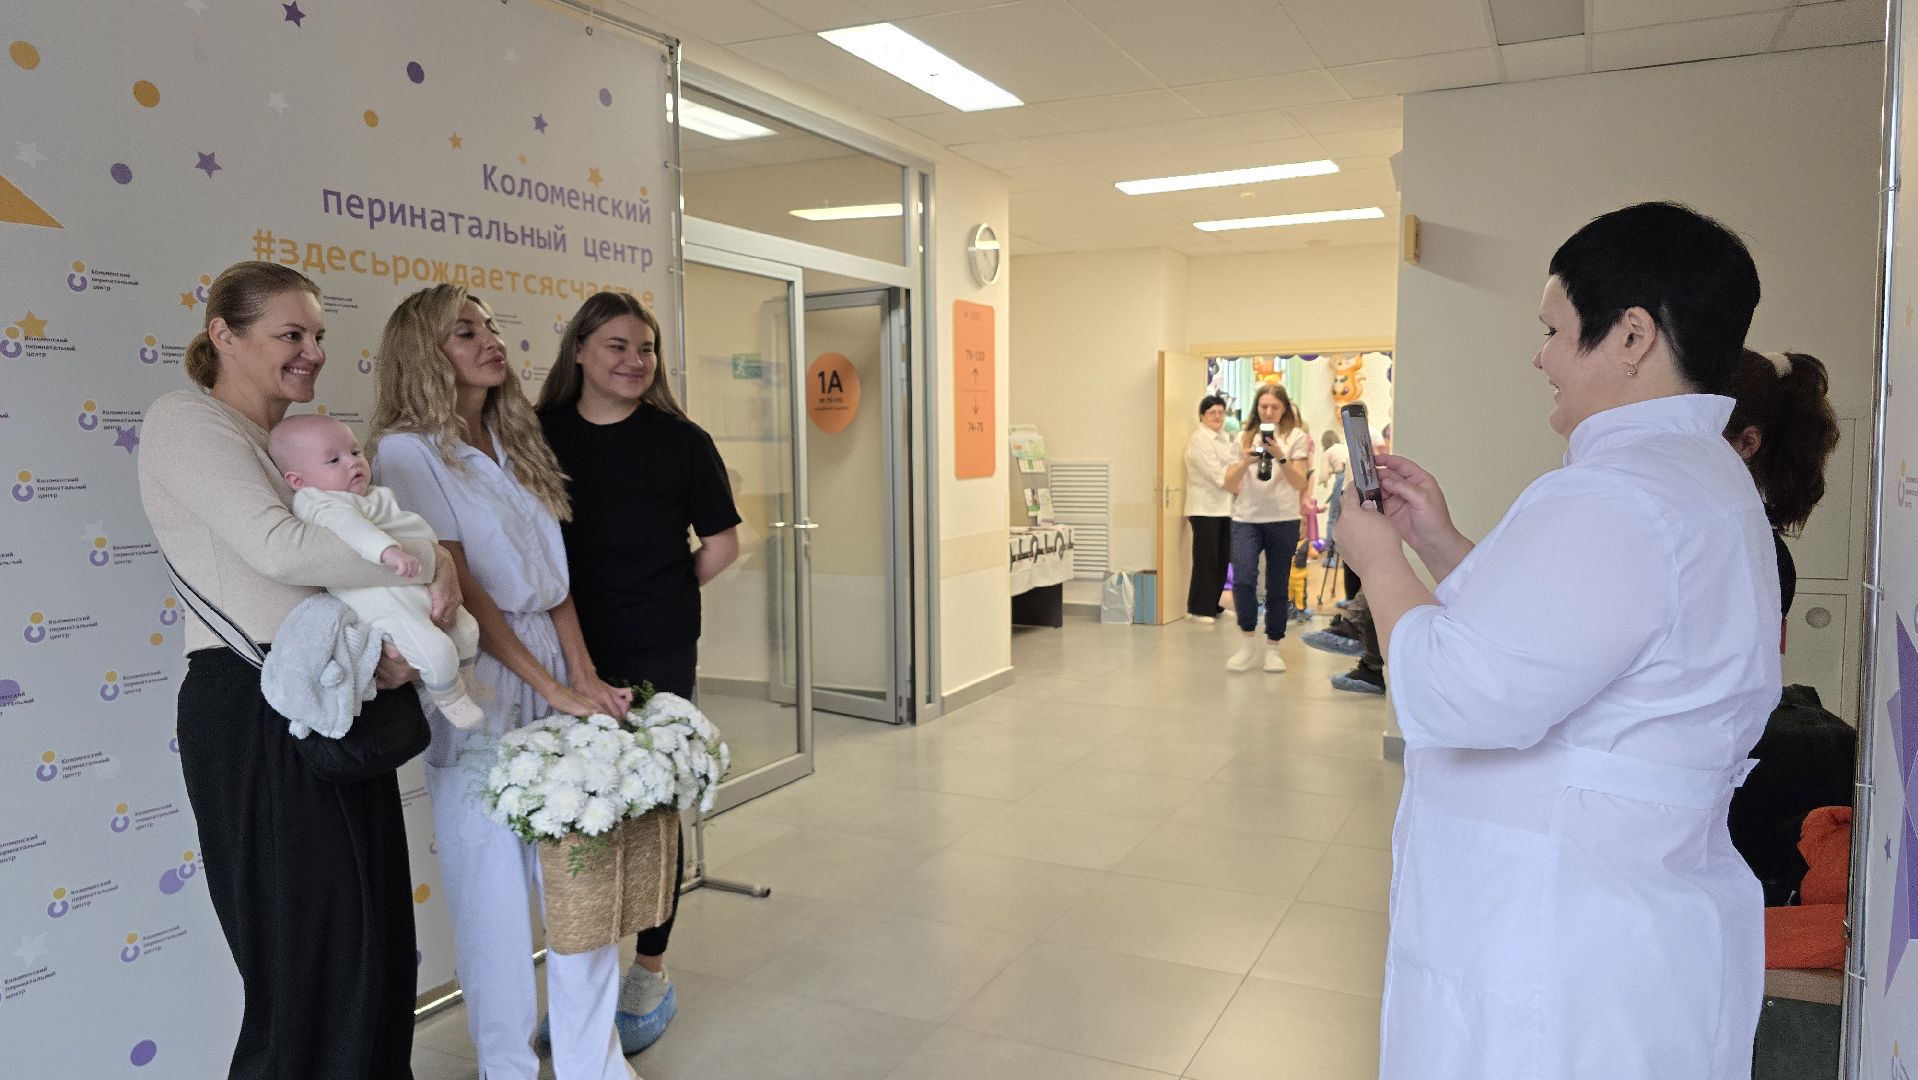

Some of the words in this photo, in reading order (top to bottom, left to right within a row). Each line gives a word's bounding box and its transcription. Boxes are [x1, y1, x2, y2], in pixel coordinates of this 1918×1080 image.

[322, 188, 568, 253] перинатальный
[583, 236, 655, 273] центр
[482, 163, 652, 225] Коломенский
